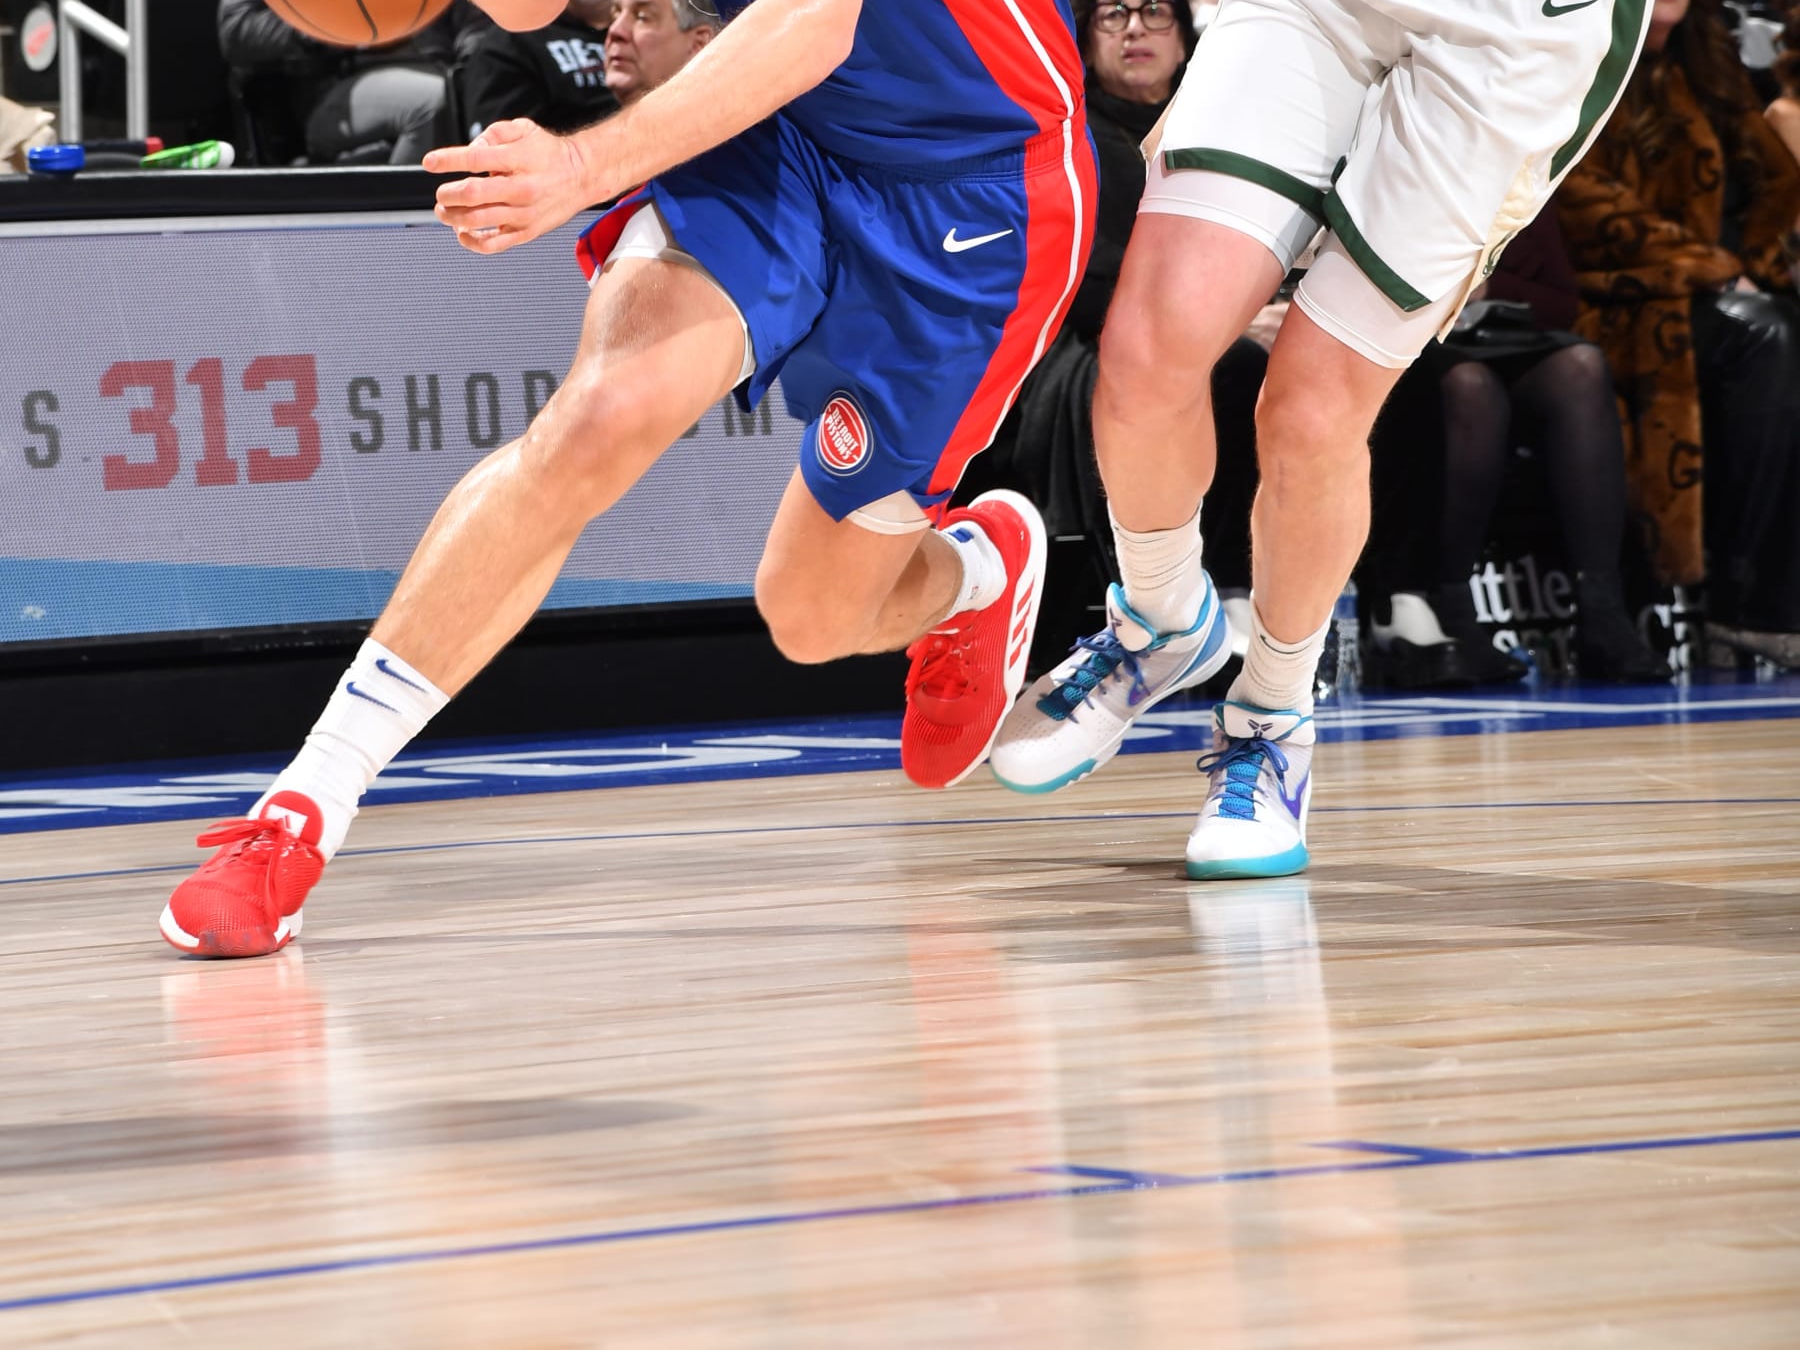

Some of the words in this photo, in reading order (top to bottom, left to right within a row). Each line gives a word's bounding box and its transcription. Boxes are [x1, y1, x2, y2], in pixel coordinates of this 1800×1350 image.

[824, 415, 853, 461] PISTONS
[831, 407, 859, 452] DETROIT
[1468, 554, 1578, 624] ittle
